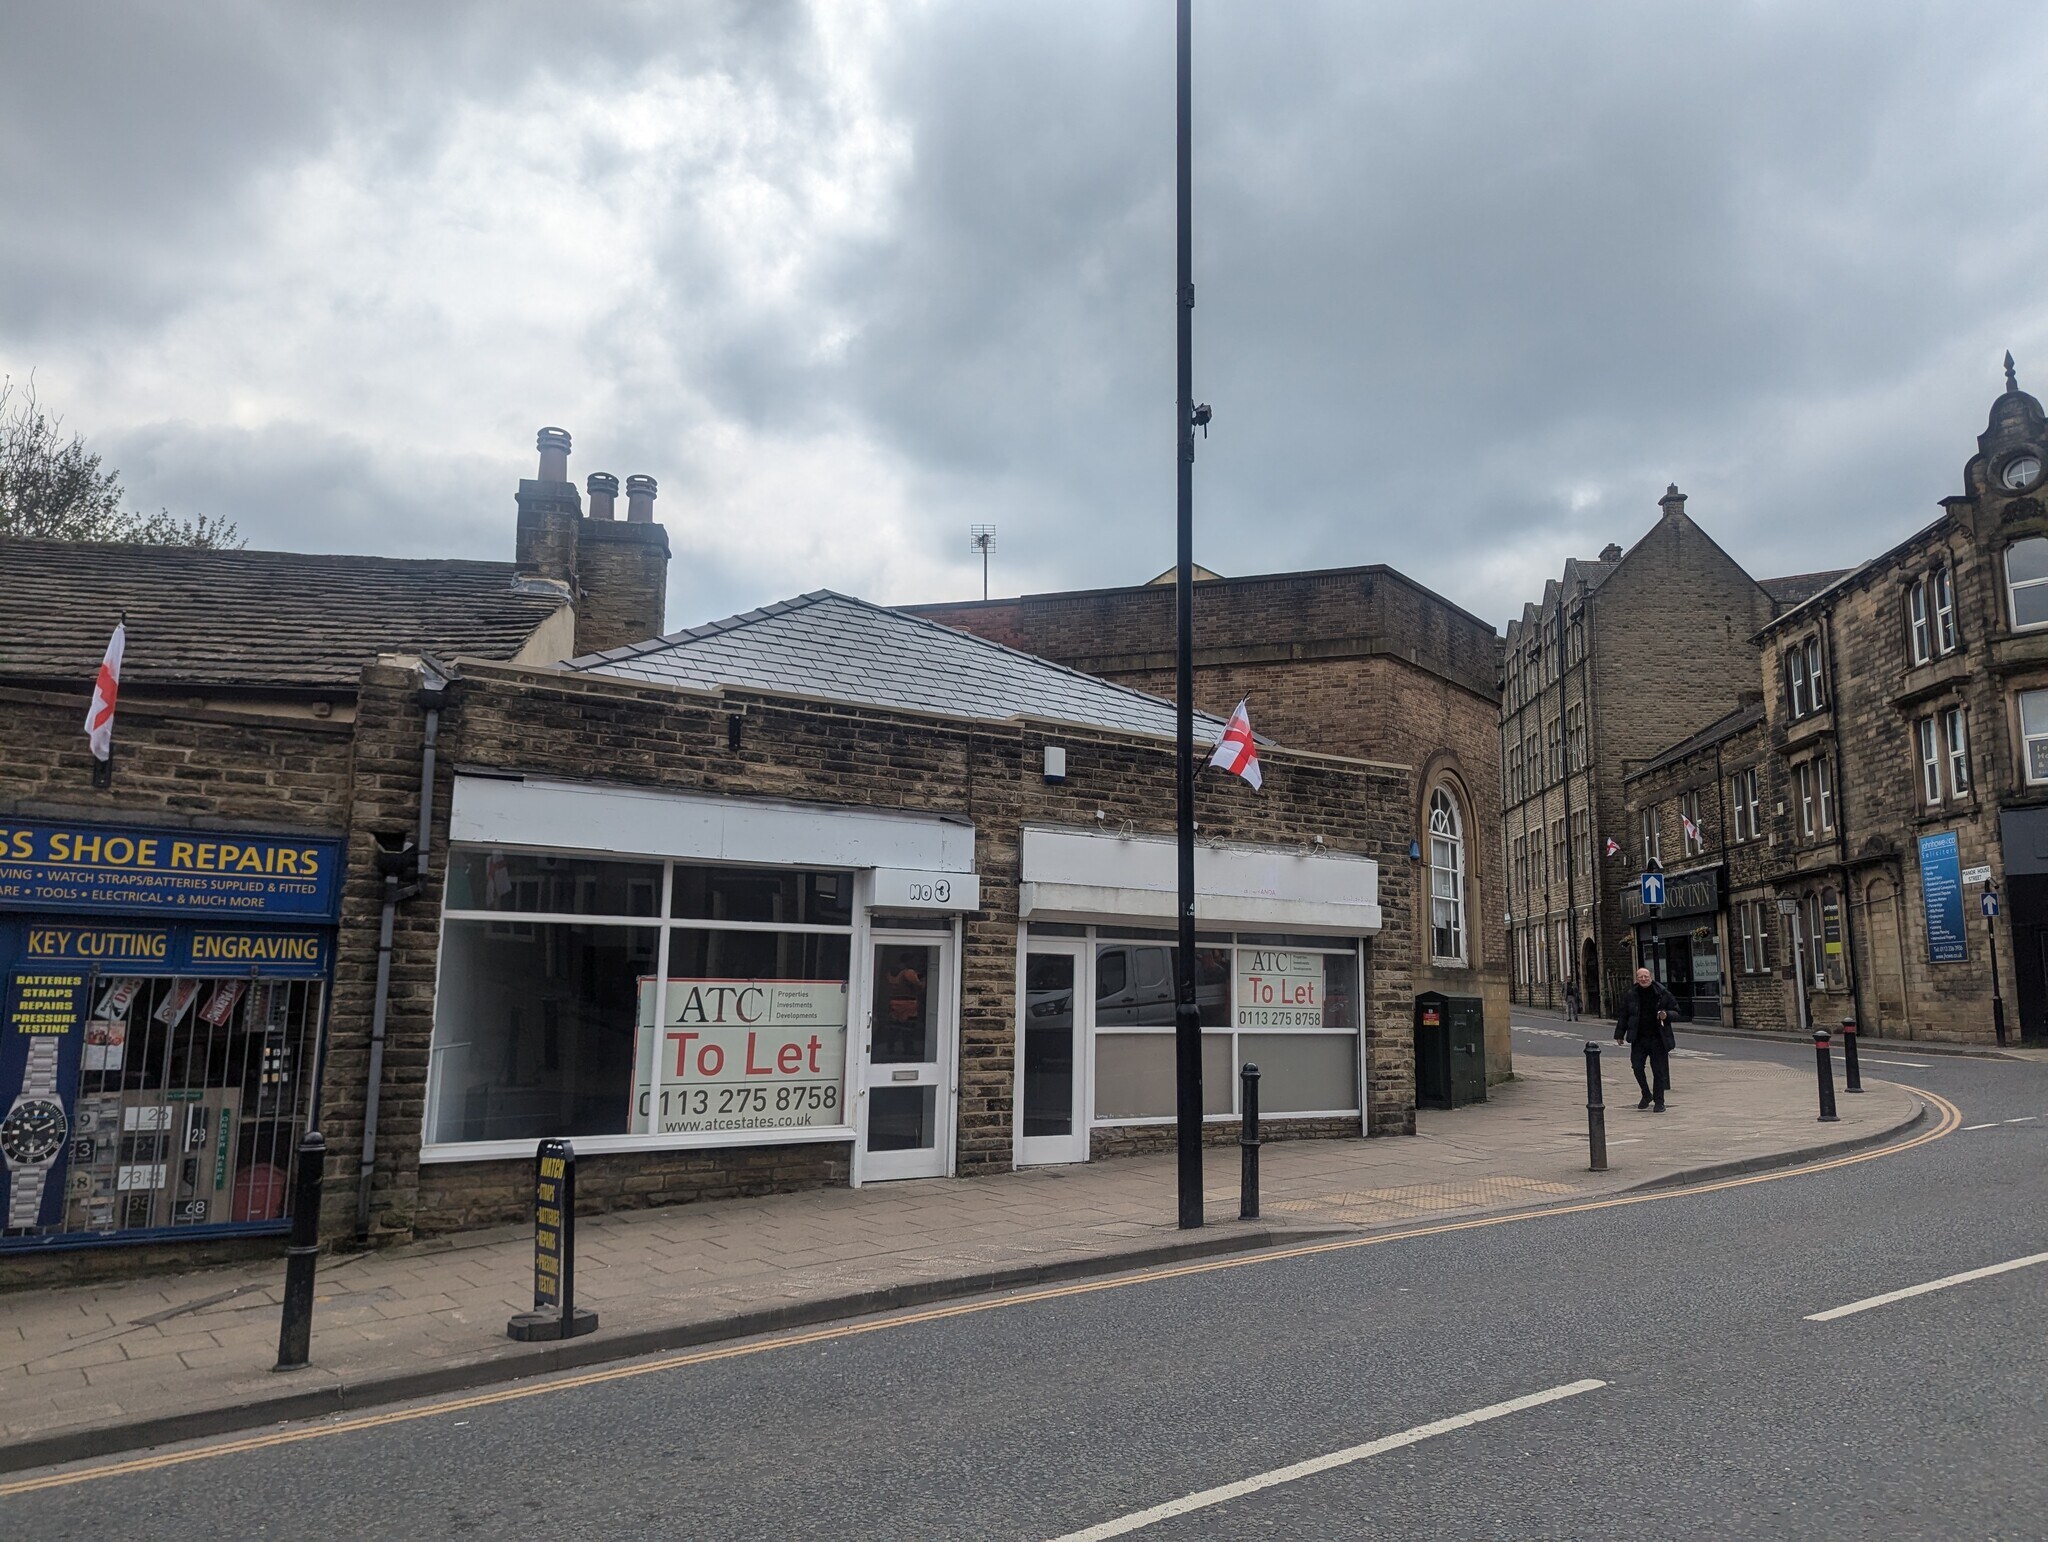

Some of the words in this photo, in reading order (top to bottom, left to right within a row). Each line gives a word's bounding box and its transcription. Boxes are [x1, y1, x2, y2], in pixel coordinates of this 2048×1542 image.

[49, 832, 158, 866] SHOE
[172, 842, 318, 875] REPAIRS
[1922, 848, 1956, 859] Solicitors
[48, 870, 94, 884] WATCH
[98, 874, 208, 890] STRAPS/BATTERIES
[210, 879, 264, 892] SUPPLIED
[268, 882, 276, 892] &
[279, 883, 316, 894] FITTED
[910, 884, 932, 901] NO
[935, 879, 951, 902] 3
[36, 887, 77, 898] TOOLS
[92, 890, 162, 903] ELECTRICAL
[177, 894, 185, 904] &
[189, 895, 226, 906] MUCH
[230, 897, 265, 907] MORE
[1688, 882, 1710, 908] INN
[28, 931, 70, 954] KEY
[77, 932, 166, 958] CUTTING
[192, 936, 318, 960] ENGRAVING
[1252, 952, 1288, 972] ATC
[16, 976, 82, 986] BATTERIES
[23, 989, 72, 998] STRAPS
[778, 990, 809, 999] Properties
[1249, 978, 1273, 1004] To
[1282, 978, 1314, 1005] Let
[20, 1001, 72, 1011] REPAIRS
[676, 986, 764, 1023] ATC
[12, 1014, 77, 1023] PRESSURE
[1240, 1011, 1268, 1025] 0113
[1272, 1012, 1292, 1025] 275
[1295, 1012, 1320, 1026] 8758
[18, 1025, 69, 1034] TESTING
[666, 1032, 724, 1077] To
[746, 1032, 822, 1075] Let
[639, 1089, 709, 1117] 0113
[718, 1088, 767, 1114] 275
[776, 1086, 837, 1111] 8758
[80, 1114, 91, 1126] 9
[666, 1113, 812, 1132] www.atcestates.co.uk
[540, 1157, 566, 1179] WATCH
[186, 1201, 205, 1214] 68
